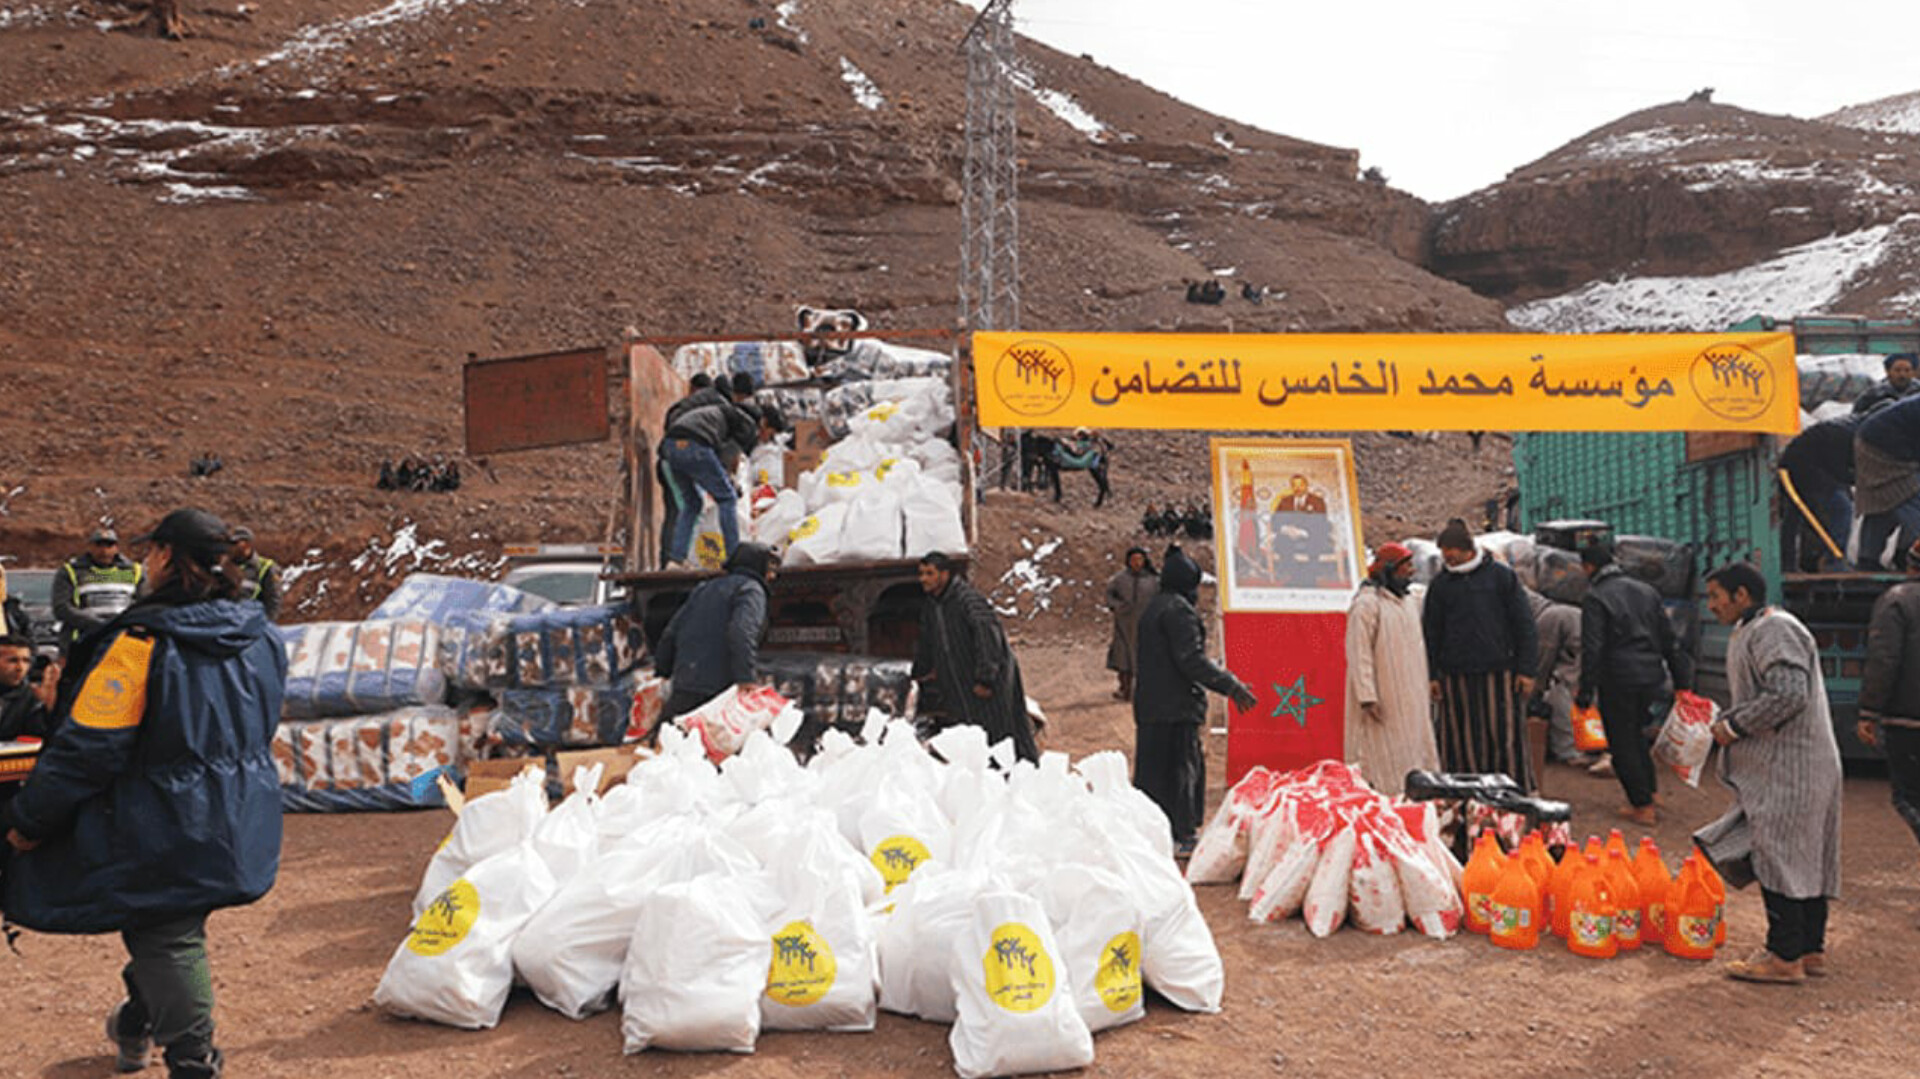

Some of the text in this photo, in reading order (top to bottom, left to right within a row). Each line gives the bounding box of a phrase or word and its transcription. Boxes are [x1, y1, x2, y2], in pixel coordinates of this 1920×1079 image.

[1090, 353, 1675, 408] مؤسسة محمد الخامس للتضامن
